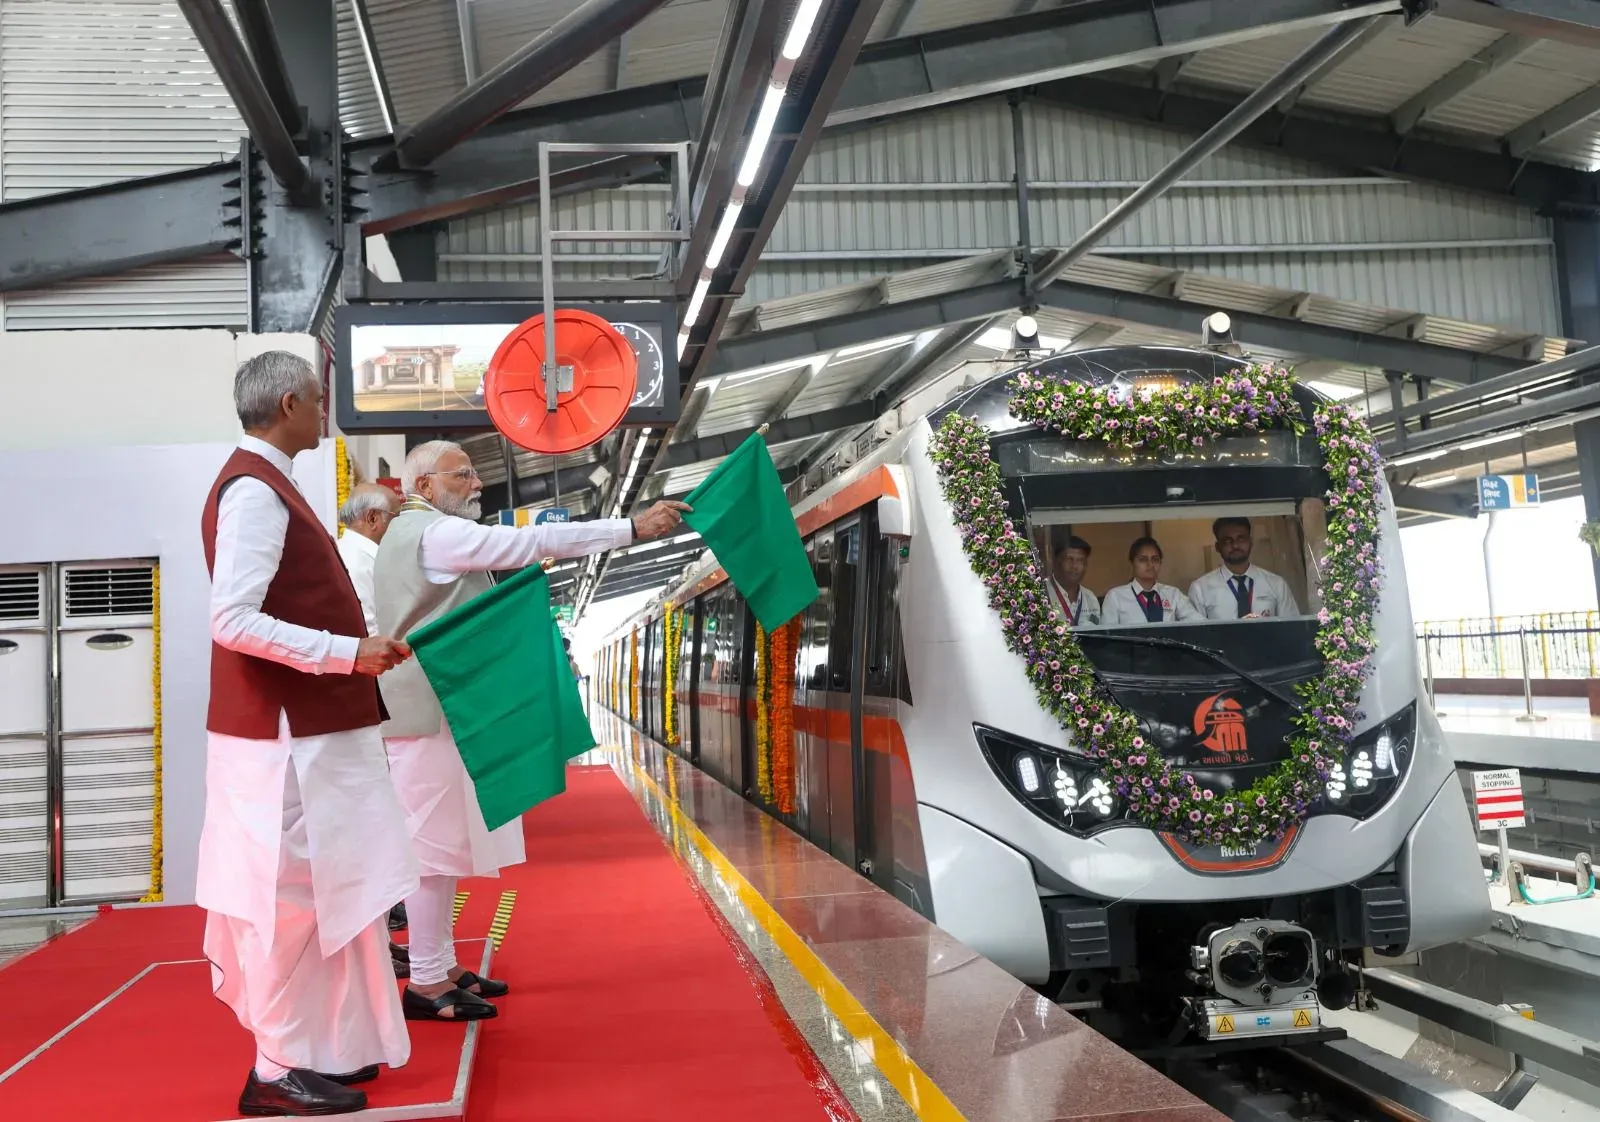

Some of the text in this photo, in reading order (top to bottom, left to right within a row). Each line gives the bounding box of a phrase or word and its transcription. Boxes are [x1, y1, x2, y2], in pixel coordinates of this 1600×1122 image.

[634, 330, 640, 340] 1
[647, 343, 655, 353] 2
[653, 360, 660, 371] 3
[648, 378, 655, 388] 4
[636, 391, 643, 401] 5
[1483, 772, 1511, 780] NORMAL
[1481, 779, 1515, 788] STOPPING
[1497, 819, 1508, 827] 3C
